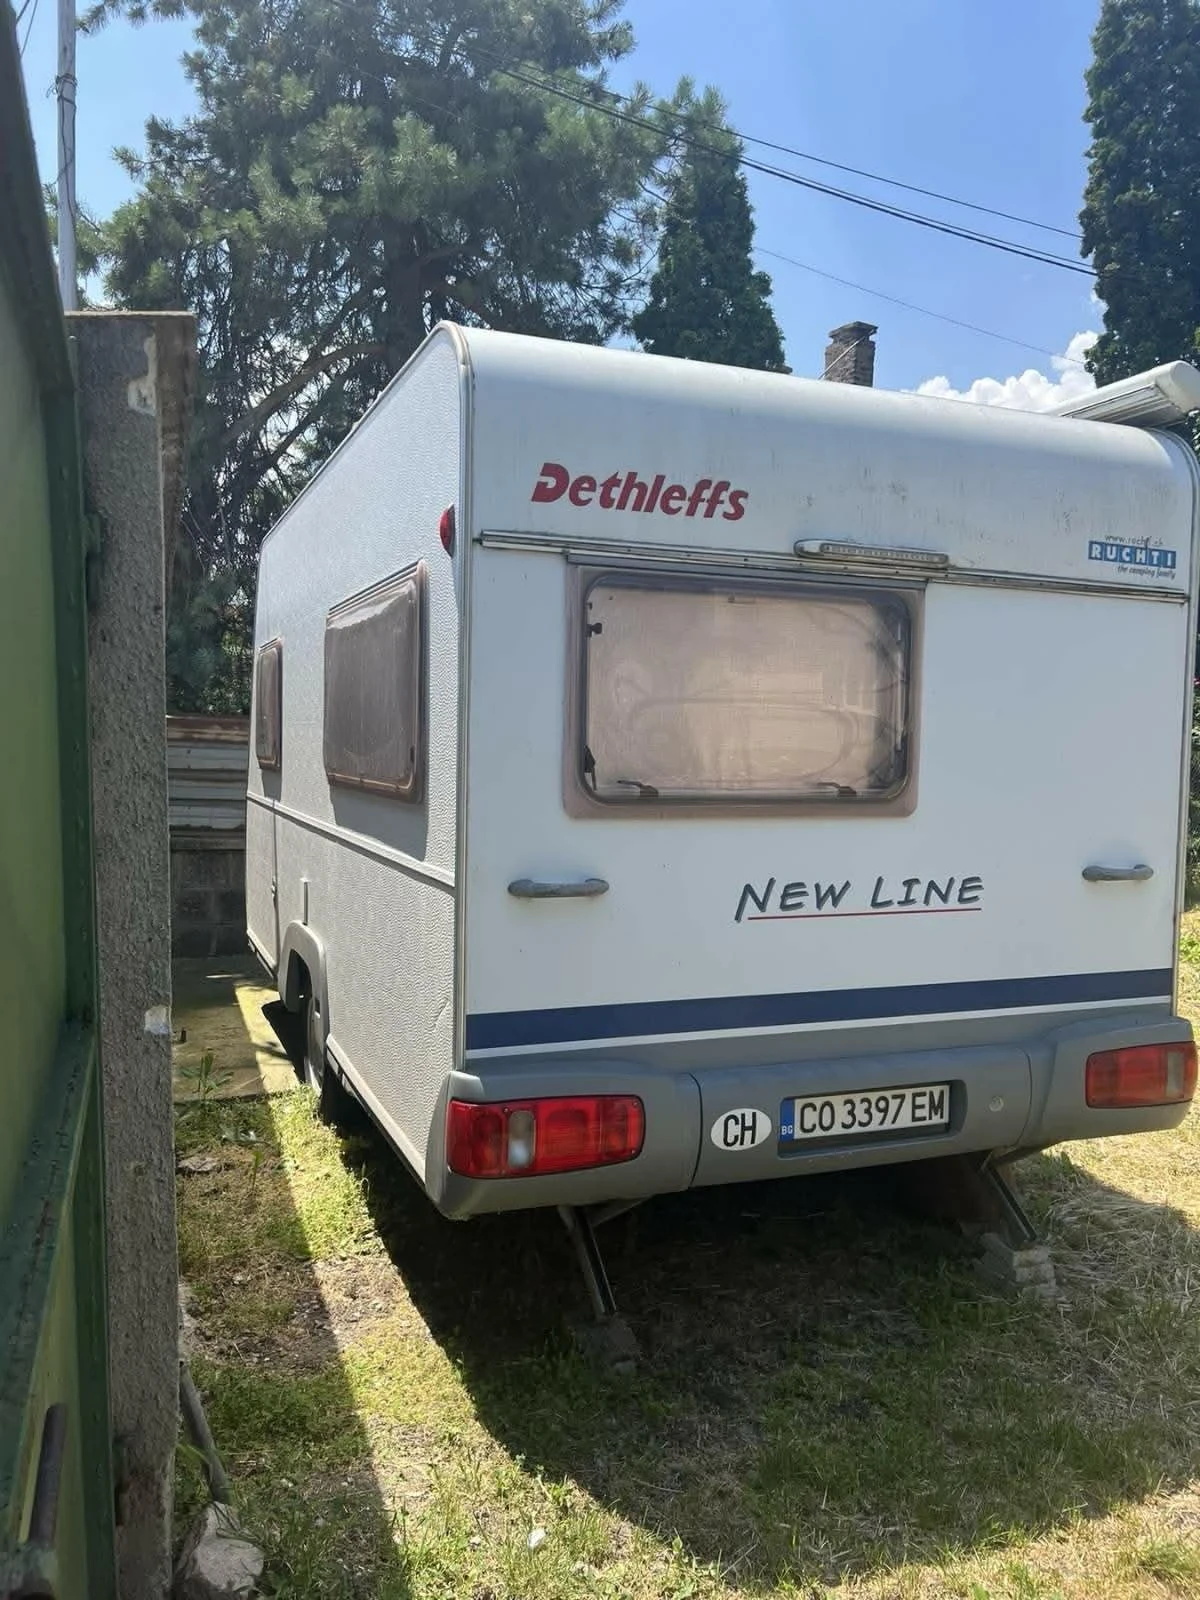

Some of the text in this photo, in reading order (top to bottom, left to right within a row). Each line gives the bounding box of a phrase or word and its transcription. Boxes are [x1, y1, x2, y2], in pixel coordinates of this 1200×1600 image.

[531, 462, 749, 521] Dethleffs
[1091, 543, 1172, 566] RUCHTI
[734, 876, 984, 923] NEW LINE
[723, 1111, 757, 1148] CH
[781, 1125, 793, 1135] BG
[800, 1089, 945, 1133] CO 3397 EM
